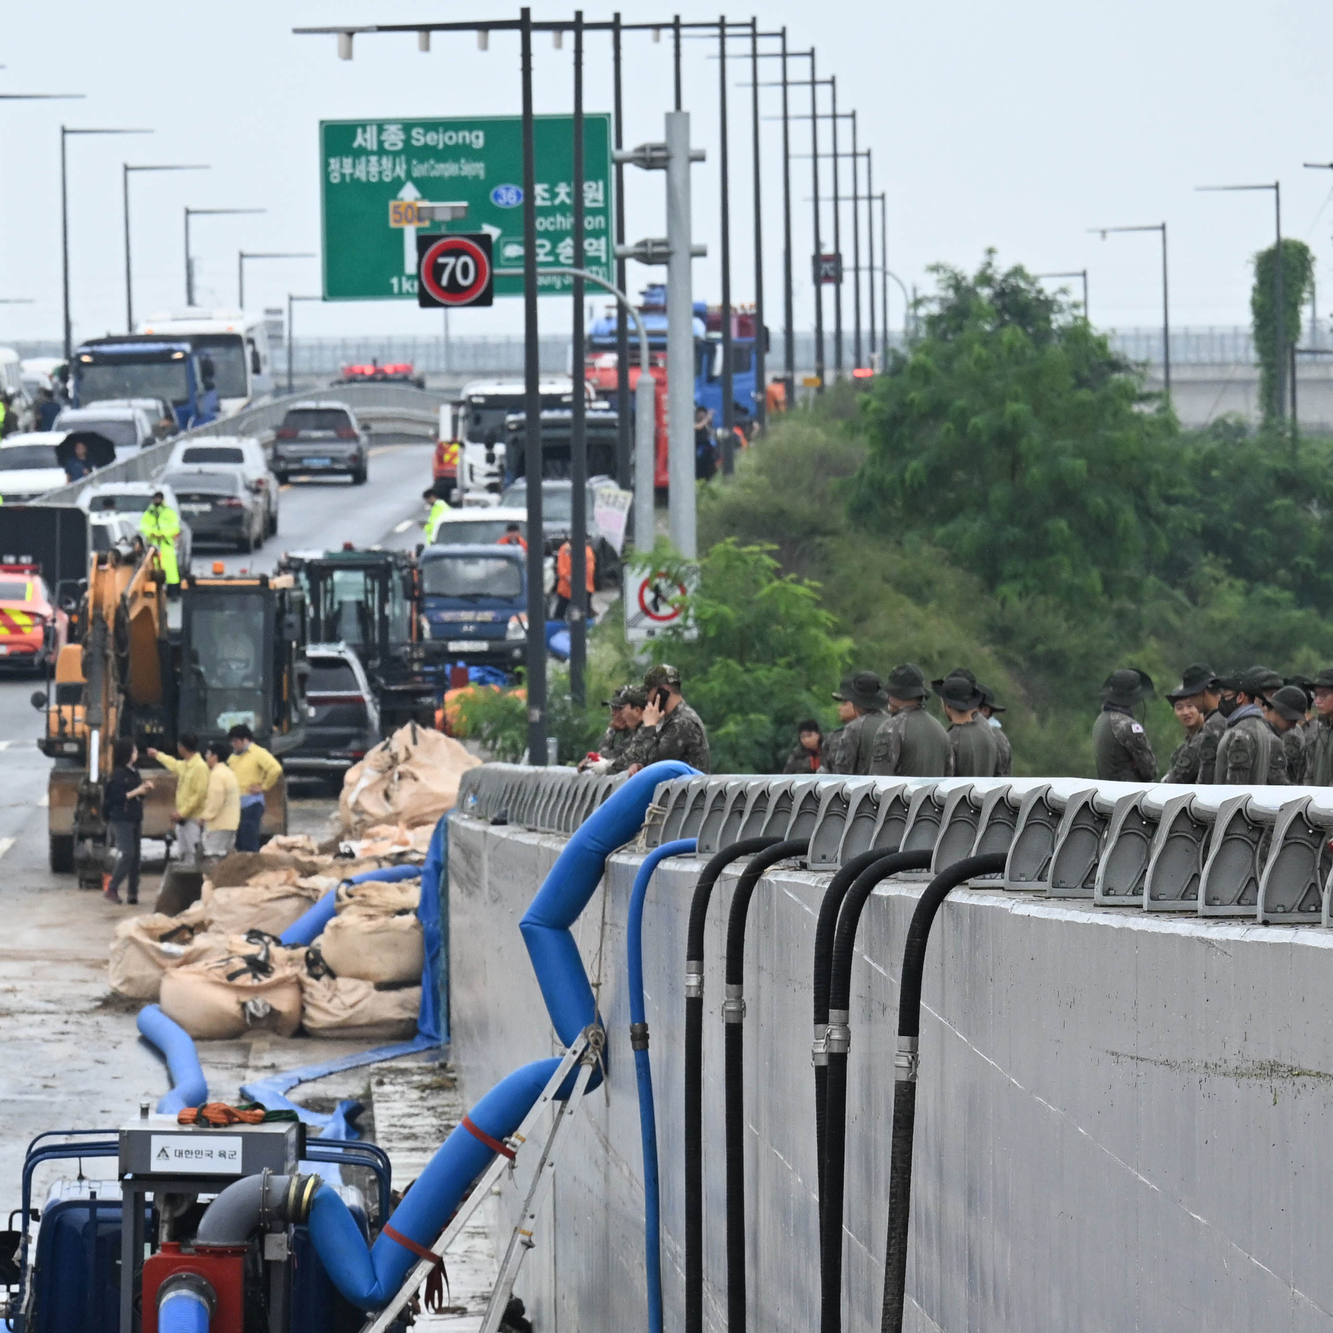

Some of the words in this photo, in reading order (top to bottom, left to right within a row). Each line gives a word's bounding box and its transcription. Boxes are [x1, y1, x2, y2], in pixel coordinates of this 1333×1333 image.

[352, 123, 406, 151] 세종
[411, 127, 485, 150] Sejong
[327, 155, 408, 184] 정부세종청사
[498, 188, 518, 203] 36
[437, 255, 475, 286] 70
[174, 1148, 214, 1160] 대한민국
[218, 1149, 237, 1161] 육군
